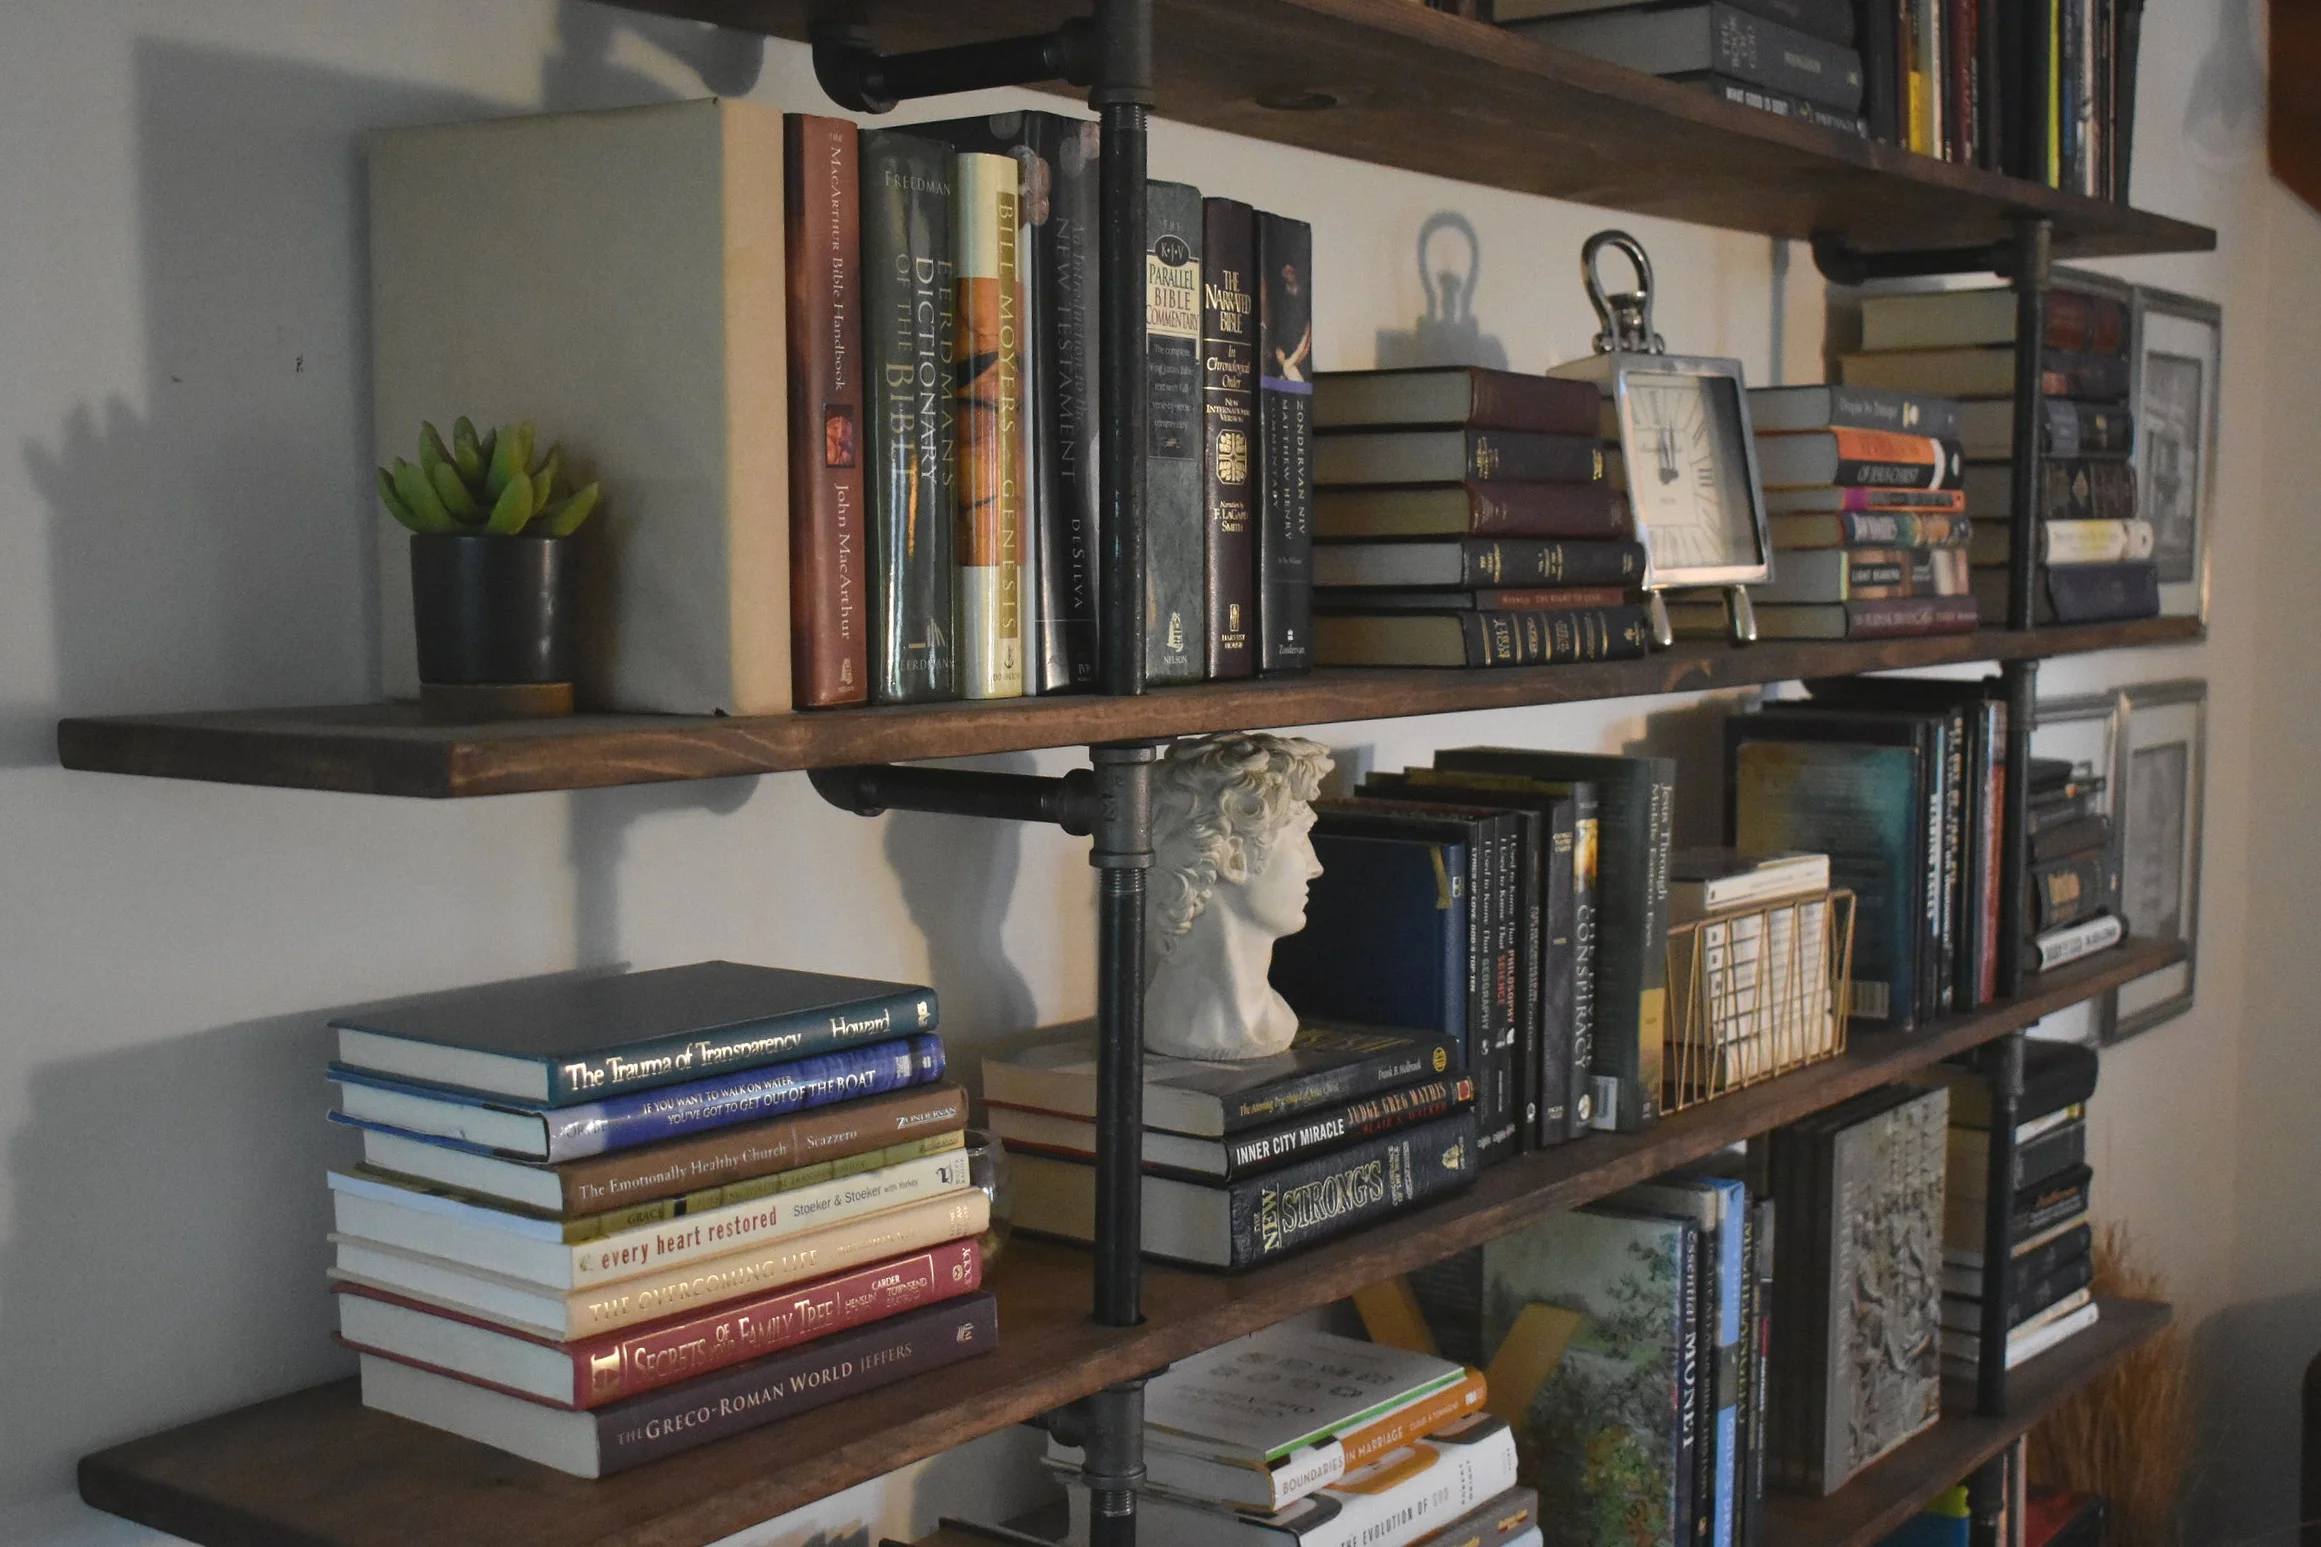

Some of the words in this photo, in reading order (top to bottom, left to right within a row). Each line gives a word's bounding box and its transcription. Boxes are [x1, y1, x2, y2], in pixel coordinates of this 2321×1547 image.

[884, 170, 952, 196] FREEDMAN
[999, 204, 1015, 276] BILL
[1055, 217, 1072, 291] NEW
[831, 256, 845, 298] Bible
[895, 253, 910, 289] OF
[1148, 263, 1196, 291] PARALLEL
[1154, 286, 1191, 311] BIBLE
[1205, 283, 1252, 314] NARRATED
[1222, 270, 1240, 292] THE
[896, 300, 913, 353] THE
[1146, 304, 1200, 331] COMMENTARY
[1220, 311, 1243, 333] BIBLE
[833, 303, 847, 393] Handbook
[915, 256, 938, 485] DICTIONARY
[936, 260, 955, 488] EERDMANS
[1000, 294, 1016, 434] MOYERS
[1228, 345, 1237, 358] In
[1058, 302, 1077, 484] TESTAMENT
[1282, 399, 1290, 481] MATTHEW
[1296, 399, 1306, 500] ZONDERVAN
[834, 482, 851, 528] John
[1284, 488, 1293, 541] HENRY
[1298, 506, 1307, 535] NIV
[1001, 480, 1016, 630] GENESIS
[839, 533, 853, 641] MacArthur
[1163, 655, 1188, 664] NELSON
[1650, 783, 1661, 841] Middle
[1660, 784, 1674, 824] Jesus
[1647, 847, 1659, 905] Eastern
[1656, 828, 1672, 901] Through
[1645, 911, 1655, 948] Eyes
[1481, 957, 1491, 1030] GEOGRAPHY
[1506, 949, 1516, 1023] PHILOSOPHY
[1574, 904, 1590, 1069] CONSPIRACY
[565, 1062, 605, 1092] The
[606, 1055, 672, 1084] Trauma
[675, 1043, 694, 1070] of
[696, 1032, 802, 1067] Transparency
[830, 1008, 891, 1039] Howard
[642, 1103, 654, 1116] IF
[655, 1099, 675, 1113] YOU
[677, 1091, 704, 1107] WANT
[705, 1089, 720, 1102] TO
[720, 1082, 746, 1098] WALK
[747, 1082, 762, 1093] ON
[763, 1075, 794, 1091] WATER
[668, 1107, 702, 1125] YOU'VE
[703, 1103, 725, 1119] GOT
[726, 1102, 739, 1115] TO
[739, 1095, 762, 1111] GET
[763, 1092, 788, 1107] OUT
[788, 1086, 809, 1104] OF
[810, 1079, 838, 1098] THE
[838, 1069, 878, 1092] BOAT
[896, 1106, 958, 1130] ZONDERVAN
[1346, 1100, 1381, 1125] JUDGE
[1381, 1093, 1409, 1115] GREG
[1408, 1082, 1447, 1106] MATHIS
[579, 1182, 607, 1202] The
[609, 1167, 688, 1193] Emotionally
[690, 1155, 740, 1179] Healthy
[740, 1144, 788, 1169] Church
[806, 1128, 859, 1150] Scazzero
[1235, 1140, 1271, 1166] INNER
[1272, 1131, 1297, 1155] CITY
[1299, 1118, 1346, 1147] MIRACLE
[792, 1197, 832, 1218] Stoeker
[833, 1193, 843, 1209] &
[844, 1182, 883, 1205] Stoeker
[884, 1181, 900, 1193] with
[899, 1175, 920, 1191] Yorkey
[1262, 1188, 1280, 1253] NEW
[1281, 1160, 1384, 1234] STRONG'S
[601, 1241, 650, 1270] every
[655, 1225, 702, 1257] heart
[708, 1204, 778, 1243] restored
[589, 1295, 630, 1322] THE
[638, 1259, 775, 1312] OVERCOMING
[782, 1248, 820, 1278] LIFE
[845, 1292, 877, 1307] HENSLIN
[871, 1274, 901, 1290] CARDER
[886, 1278, 928, 1297] TOWNSEND
[634, 1336, 707, 1371] SECRETS
[715, 1322, 732, 1342] OF
[738, 1315, 793, 1342] FAMILY
[794, 1298, 835, 1325] TREE
[618, 1427, 643, 1446] THE
[645, 1381, 785, 1440] GRECO-ROMAN
[789, 1360, 855, 1393] WORLD
[859, 1341, 915, 1373] JEFFERS
[1682, 1330, 1698, 1450] MONET
[1281, 1456, 1344, 1497] BOUNDARIES
[1345, 1447, 1358, 1463] IN
[1357, 1427, 1404, 1458] MARRIAGE
[1361, 1506, 1414, 1547] EVOLUTION
[1417, 1497, 1429, 1516] OF
[1431, 1485, 1451, 1508] GOD
